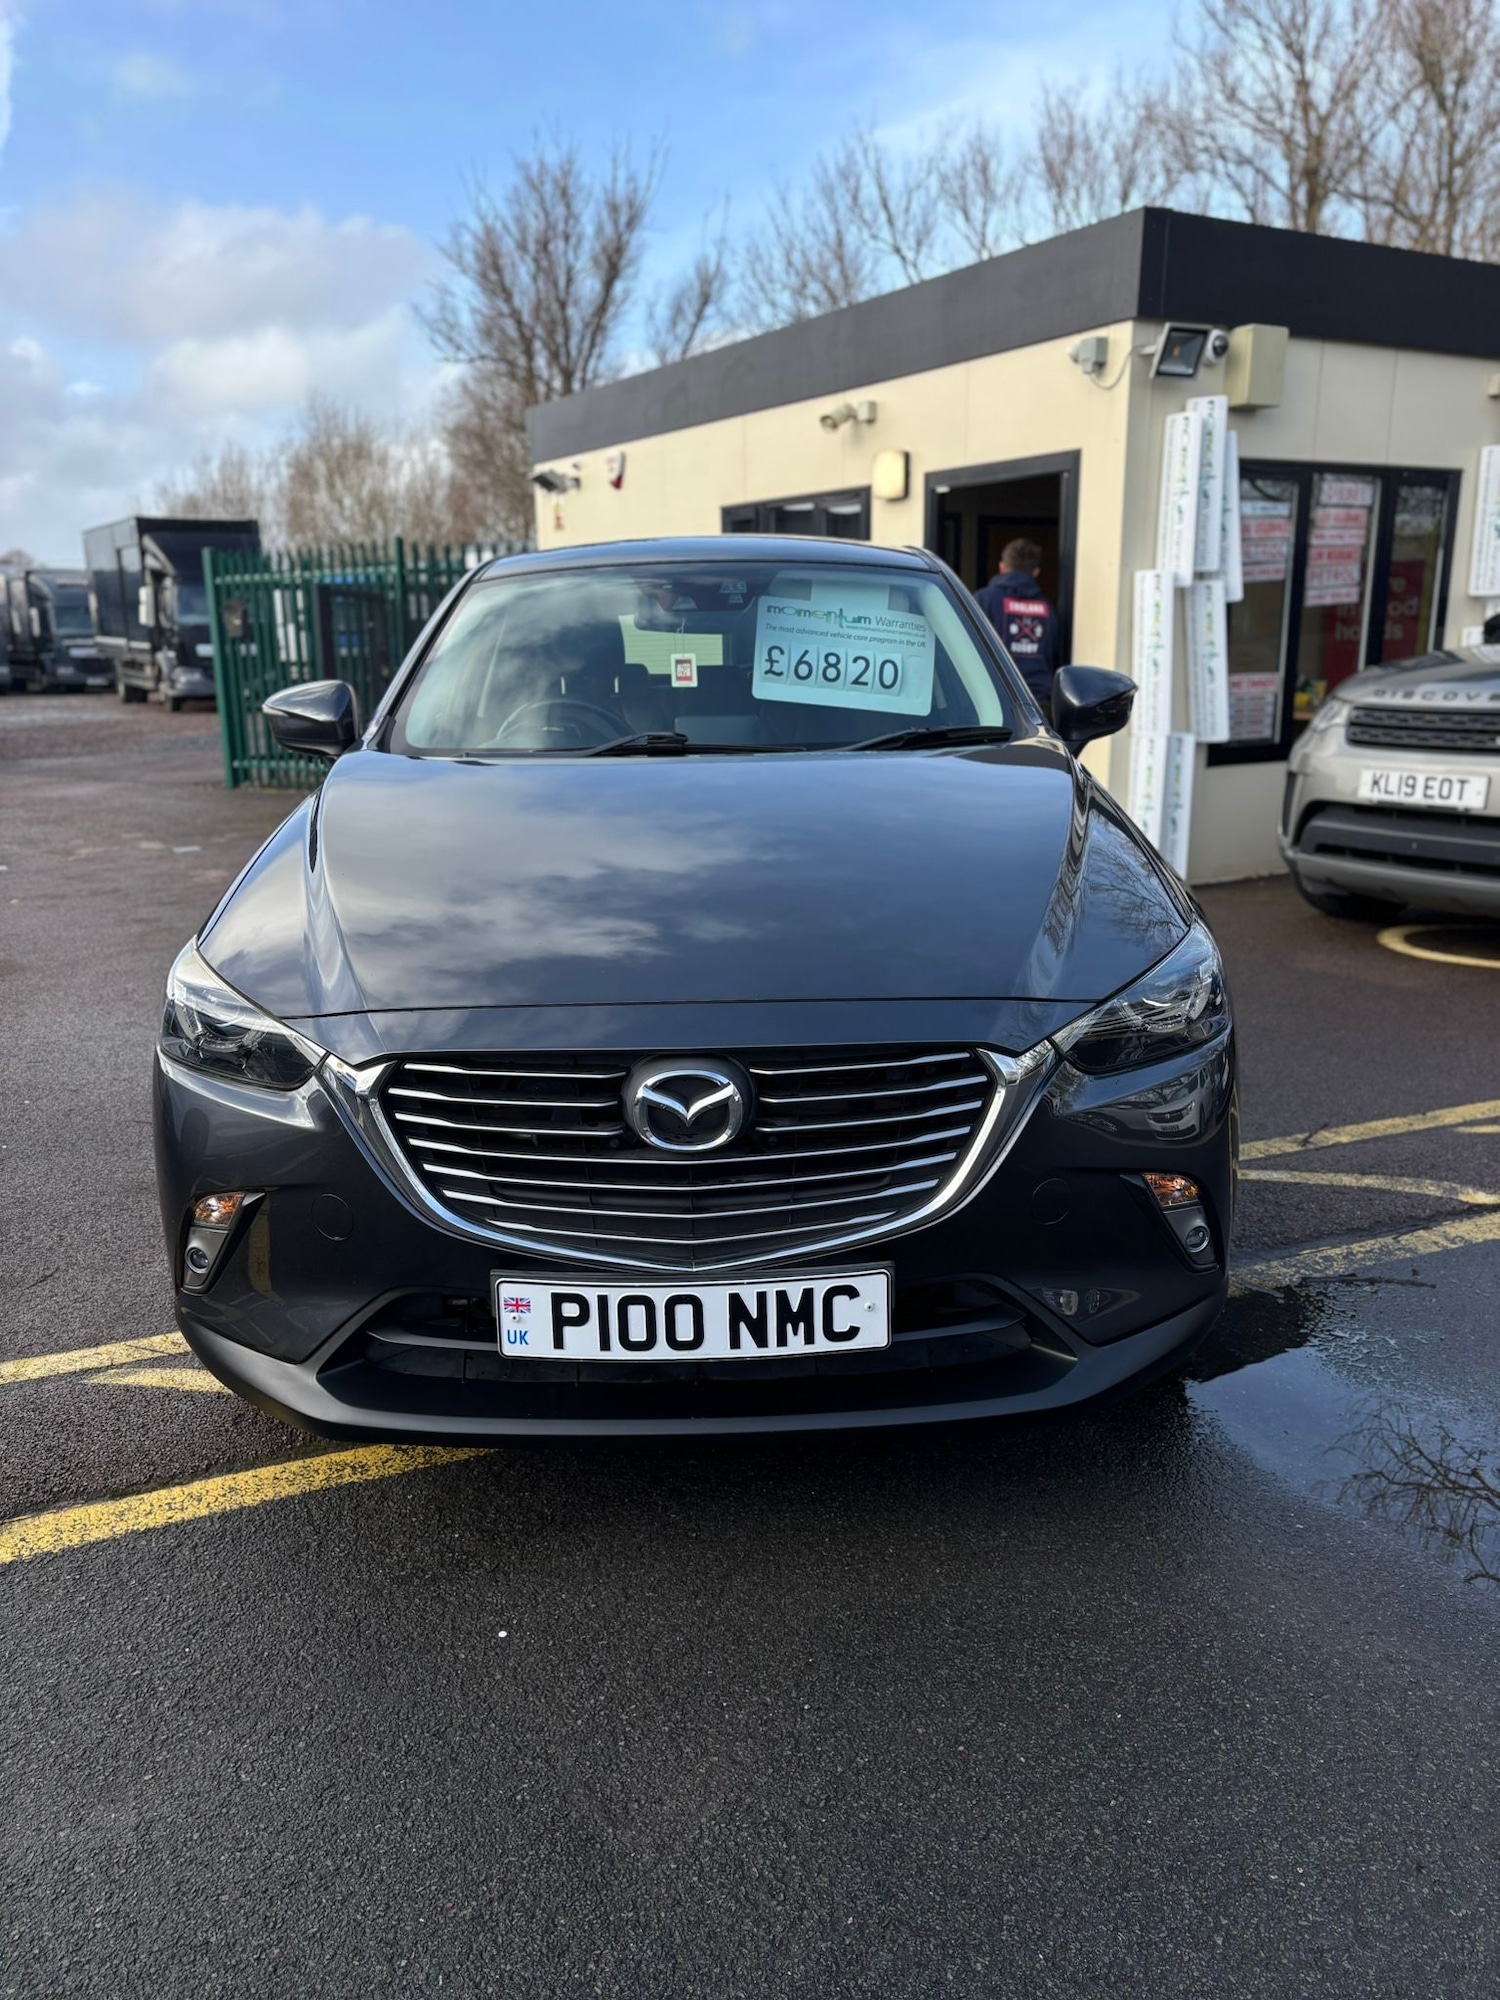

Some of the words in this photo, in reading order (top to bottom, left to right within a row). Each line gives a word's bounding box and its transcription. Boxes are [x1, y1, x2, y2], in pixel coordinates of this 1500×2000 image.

[767, 605, 871, 629] momentum
[874, 616, 927, 633] Warranties
[765, 623, 778, 632] The
[778, 625, 795, 634] most
[796, 628, 828, 637] advanced
[830, 632, 852, 640] vehicle
[906, 639, 916, 647] the
[917, 640, 927, 648] UK
[764, 645, 899, 690] £6820
[1370, 772, 1418, 797] KL19
[1422, 776, 1470, 801] EOT
[550, 1291, 704, 1351] P100
[728, 1284, 861, 1350] NMC
[506, 1329, 530, 1346] UK
